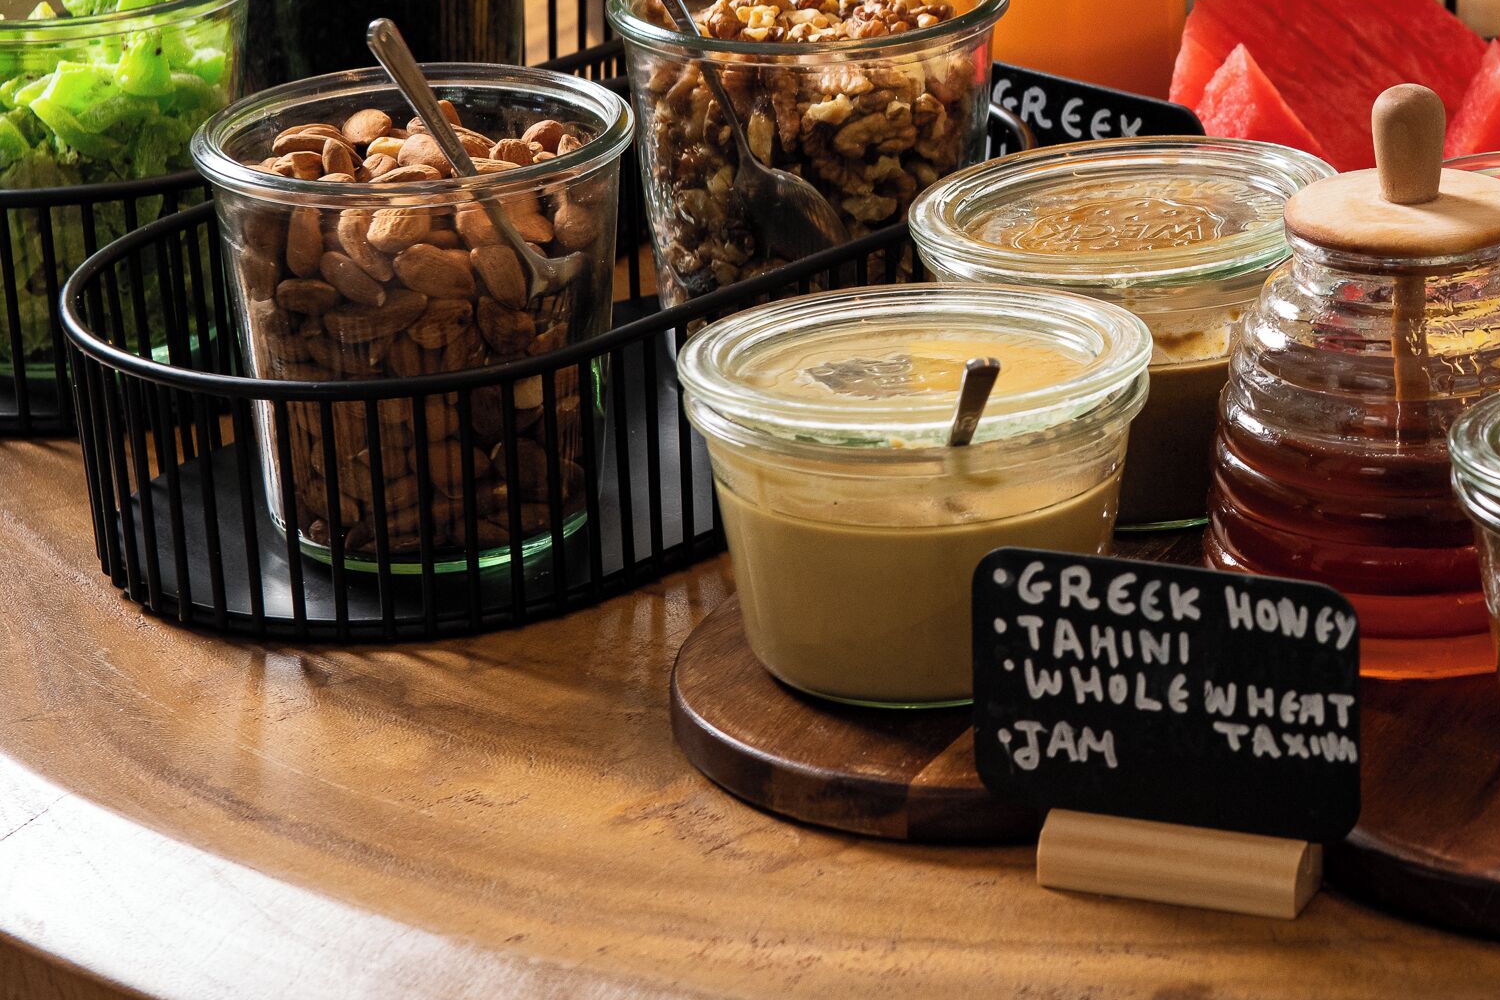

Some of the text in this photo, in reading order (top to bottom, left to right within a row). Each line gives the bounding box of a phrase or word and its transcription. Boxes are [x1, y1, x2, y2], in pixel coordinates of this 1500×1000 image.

[1017, 561, 1356, 650] GREEK HONEY
[1017, 615, 1189, 668] TAHINI
[1025, 659, 1354, 727] WHOLE WHEAT
[1014, 720, 1118, 769] JAM
